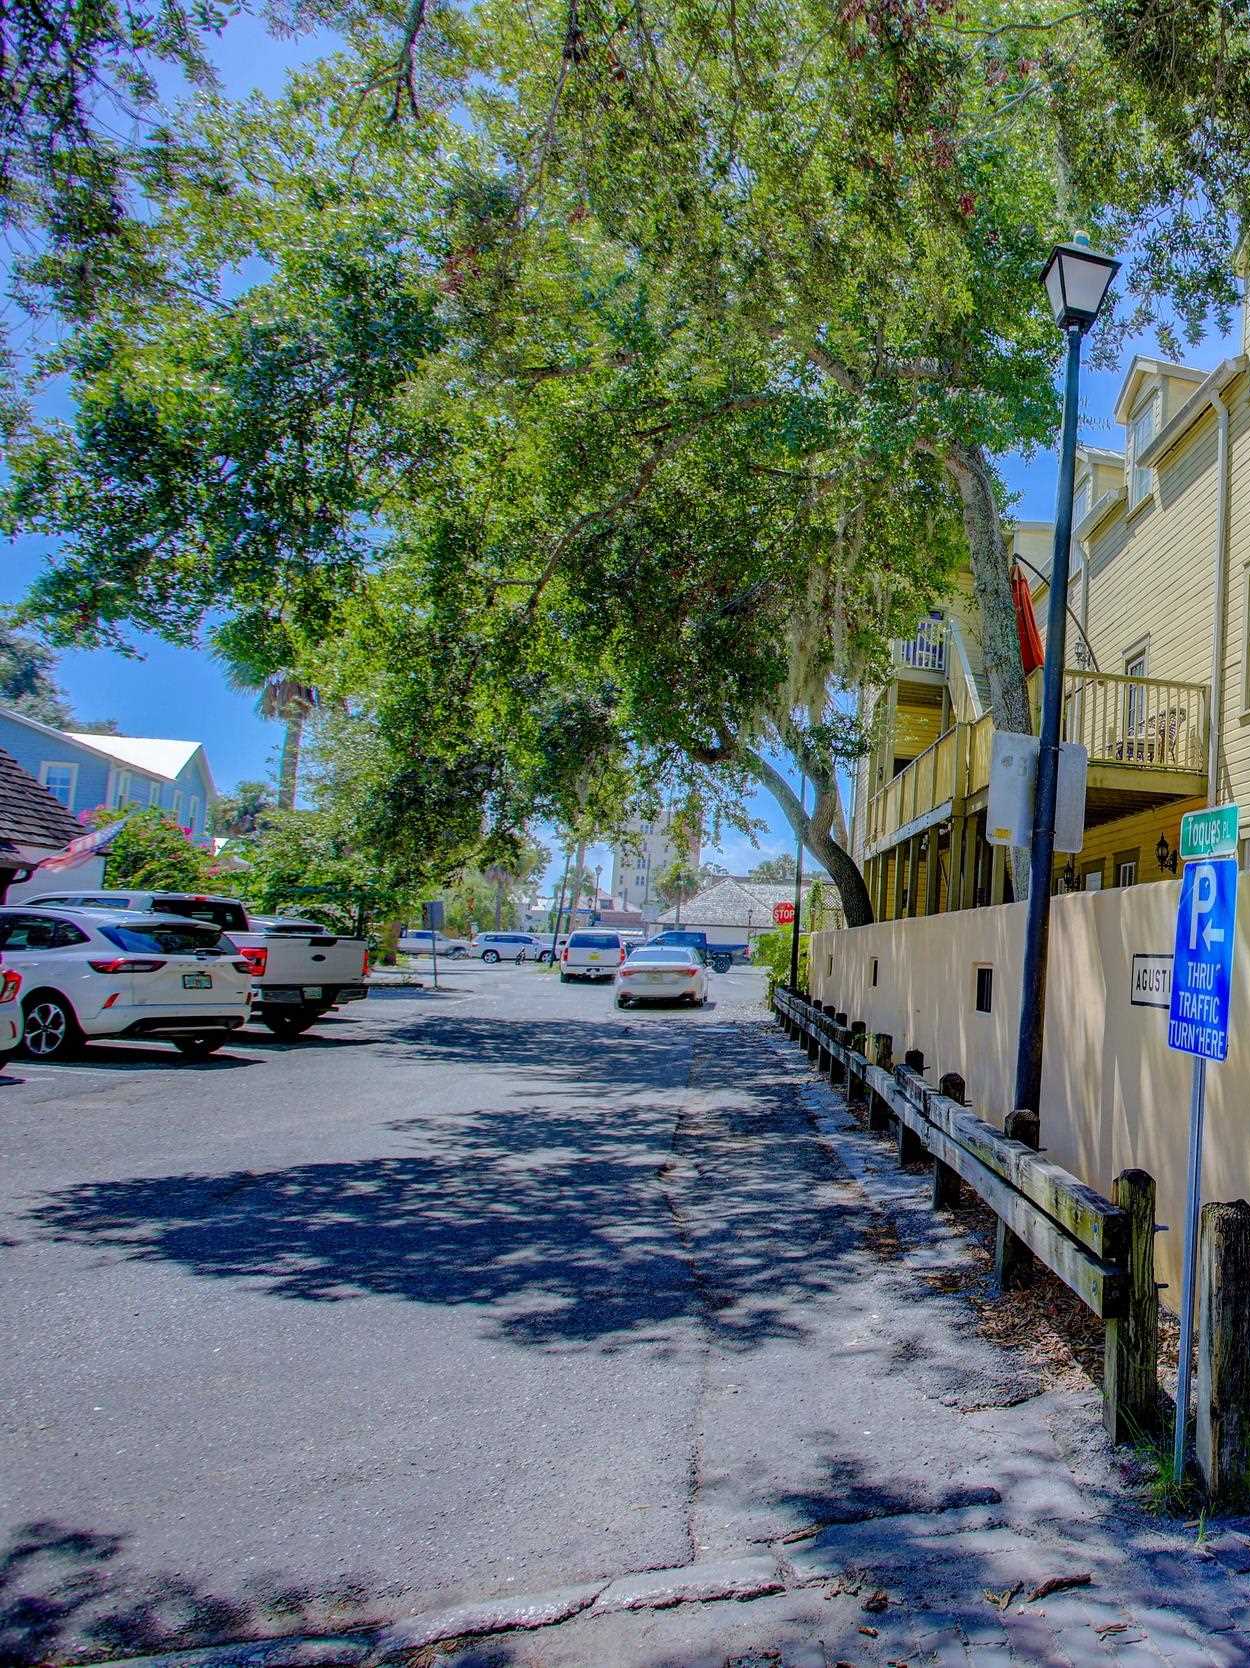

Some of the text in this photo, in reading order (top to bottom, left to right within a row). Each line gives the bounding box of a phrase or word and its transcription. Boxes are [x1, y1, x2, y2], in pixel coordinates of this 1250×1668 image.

[1188, 817, 1230, 852] Toques PL
[774, 910, 794, 919] STOP
[1189, 864, 1217, 950] P
[1136, 969, 1171, 992] AGUSTI
[1178, 991, 1220, 1024] TRAFFIC
[1170, 1020, 1224, 1058] TURN HERE
